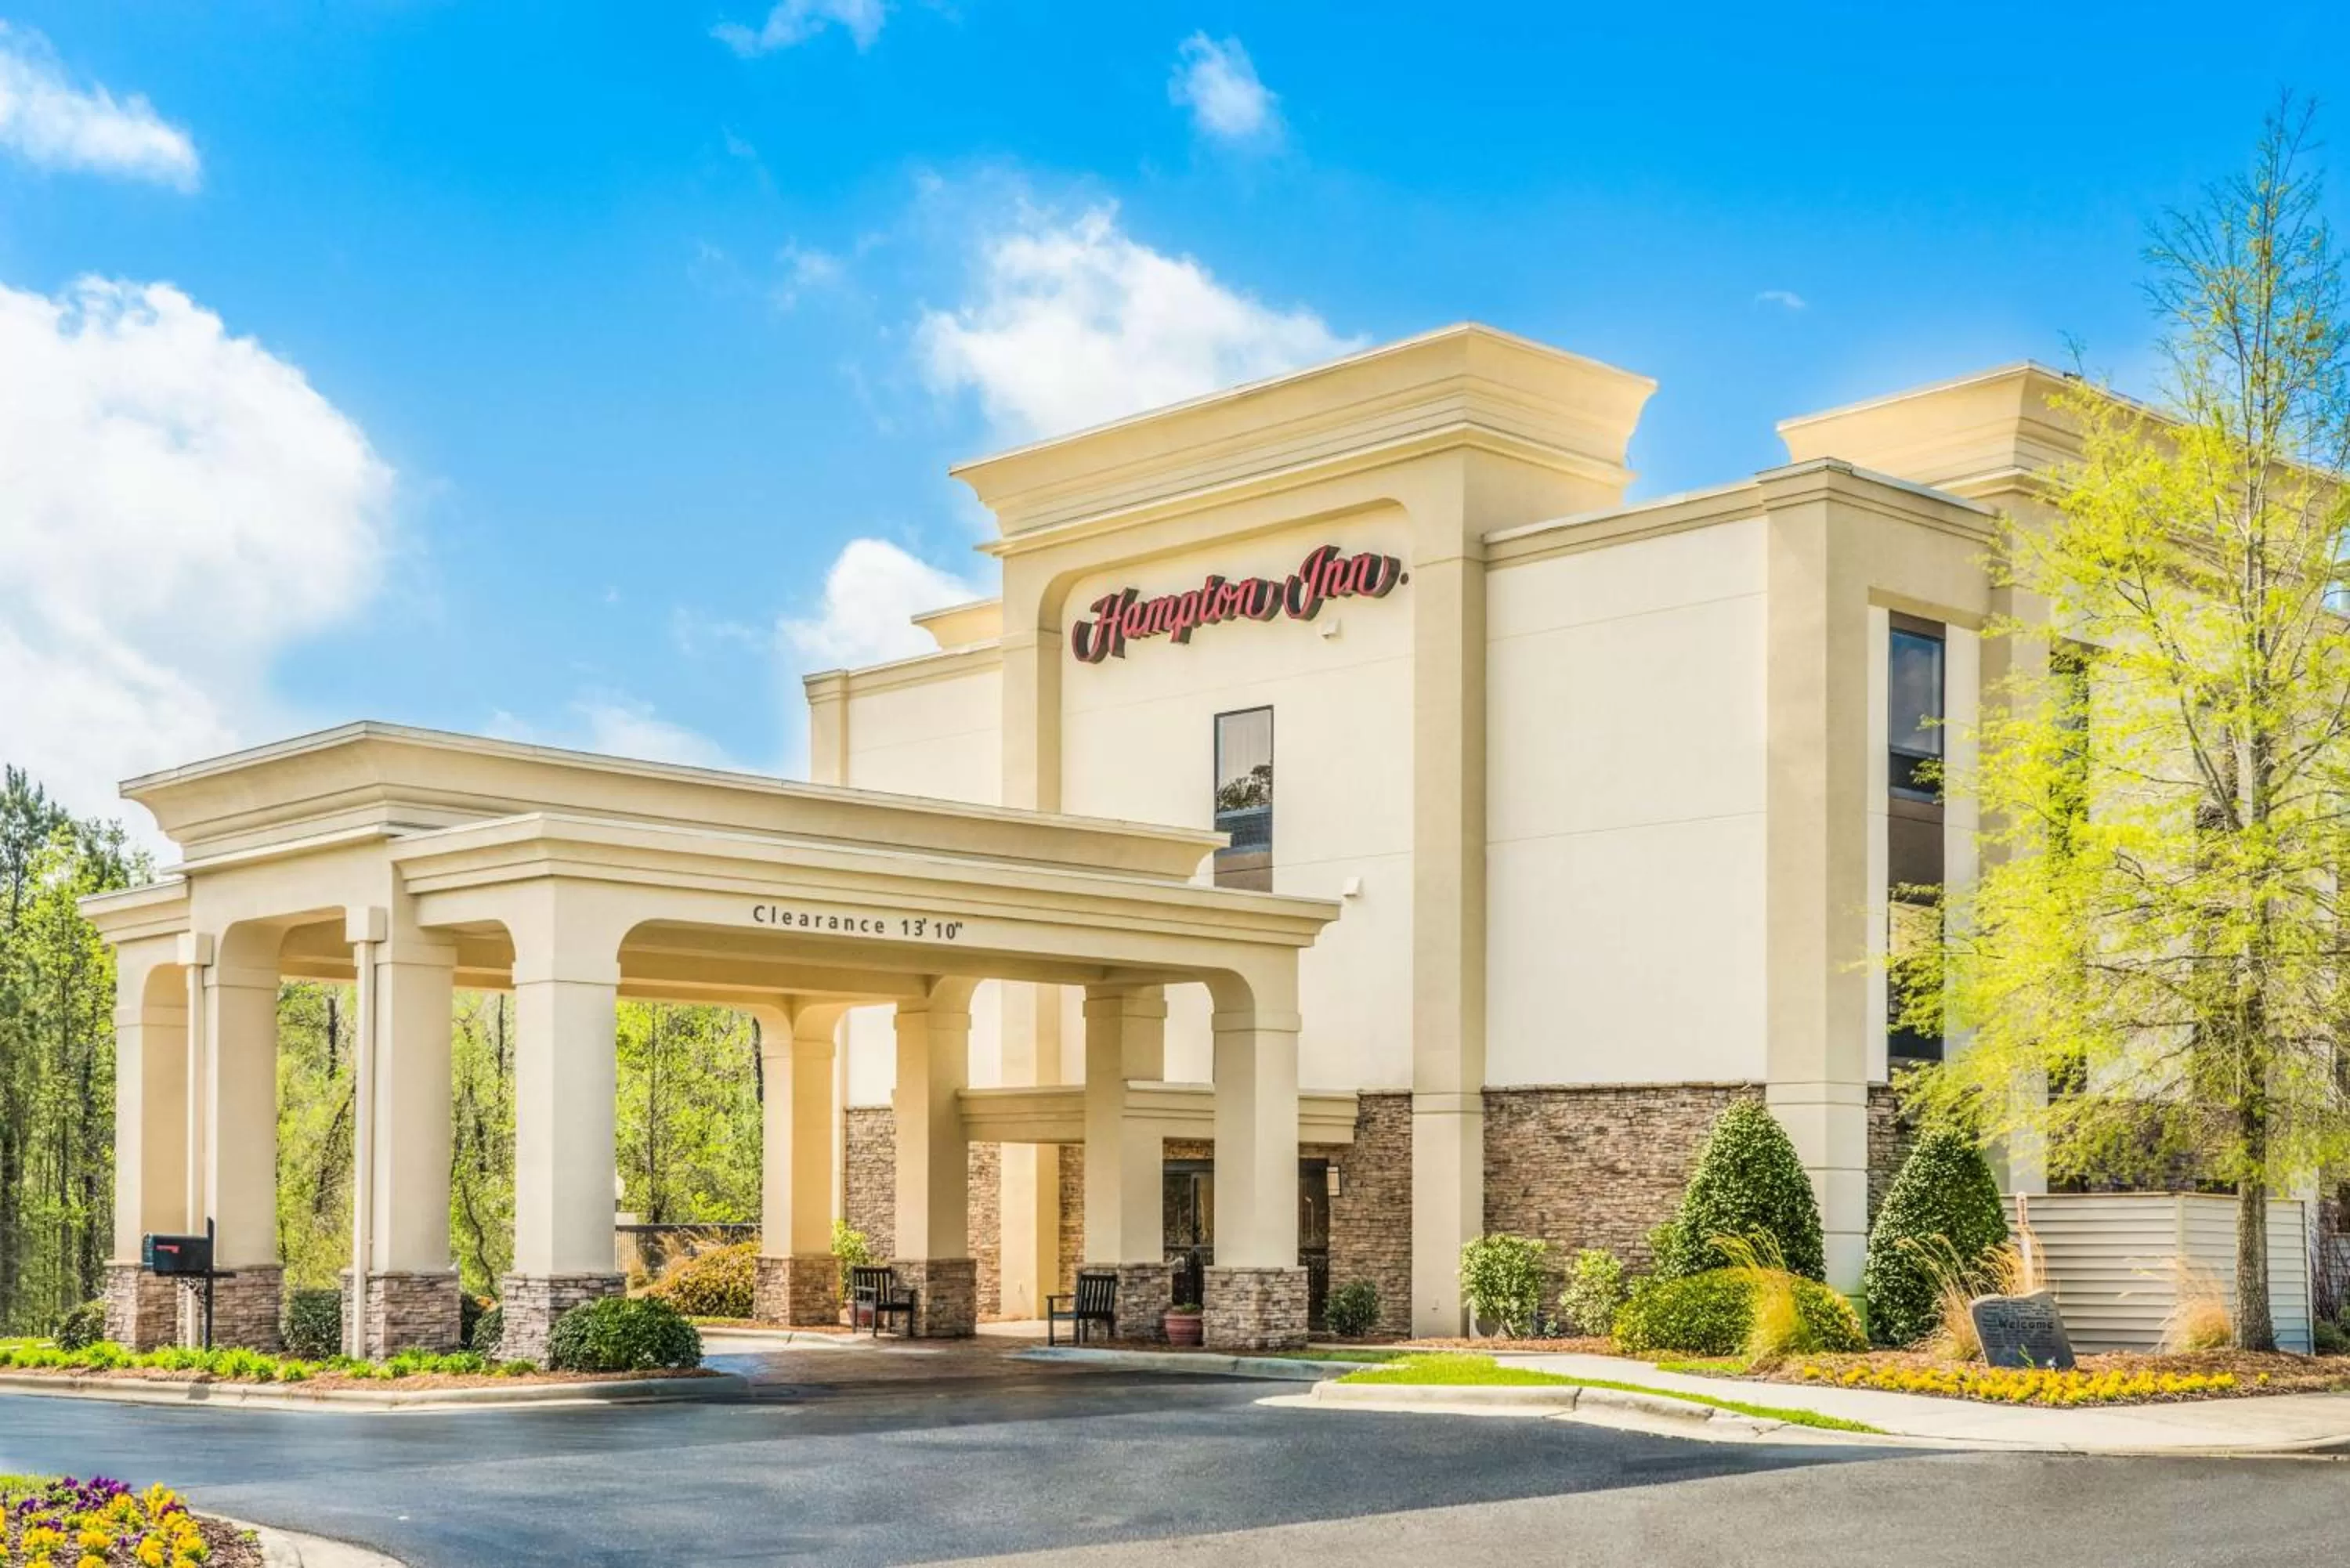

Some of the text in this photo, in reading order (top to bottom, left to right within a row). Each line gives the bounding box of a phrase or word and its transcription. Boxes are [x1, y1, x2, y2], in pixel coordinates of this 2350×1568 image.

[1072, 575, 1283, 664] Hampton
[753, 905, 884, 933] Clearance
[1999, 1319, 2054, 1329] Welcome
